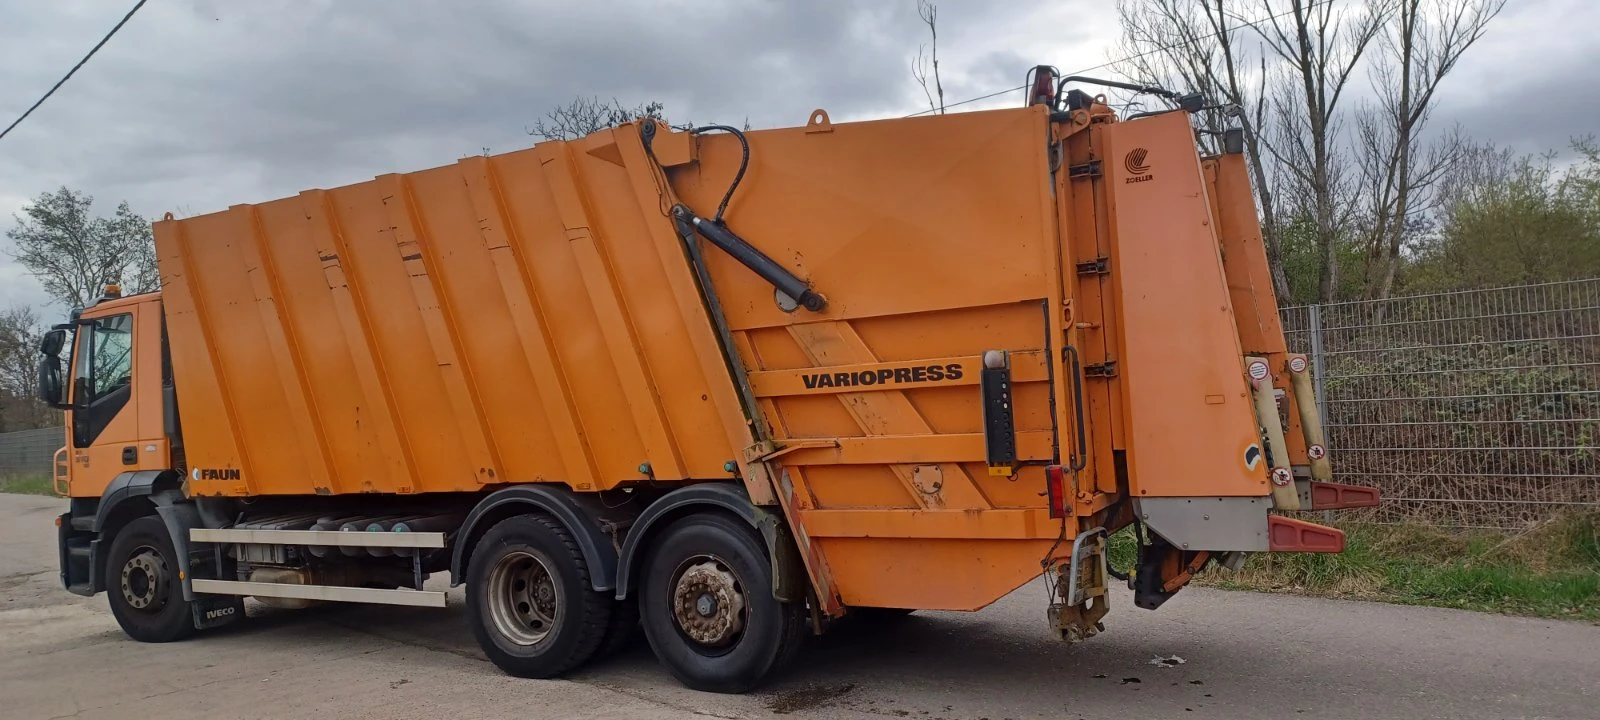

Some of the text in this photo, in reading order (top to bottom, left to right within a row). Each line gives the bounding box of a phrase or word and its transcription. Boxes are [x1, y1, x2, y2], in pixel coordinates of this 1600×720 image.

[1125, 174, 1154, 184] ZOELLER
[802, 363, 963, 389] VARIOPRESS
[201, 469, 241, 481] FAUN
[206, 607, 235, 619] IVECO
